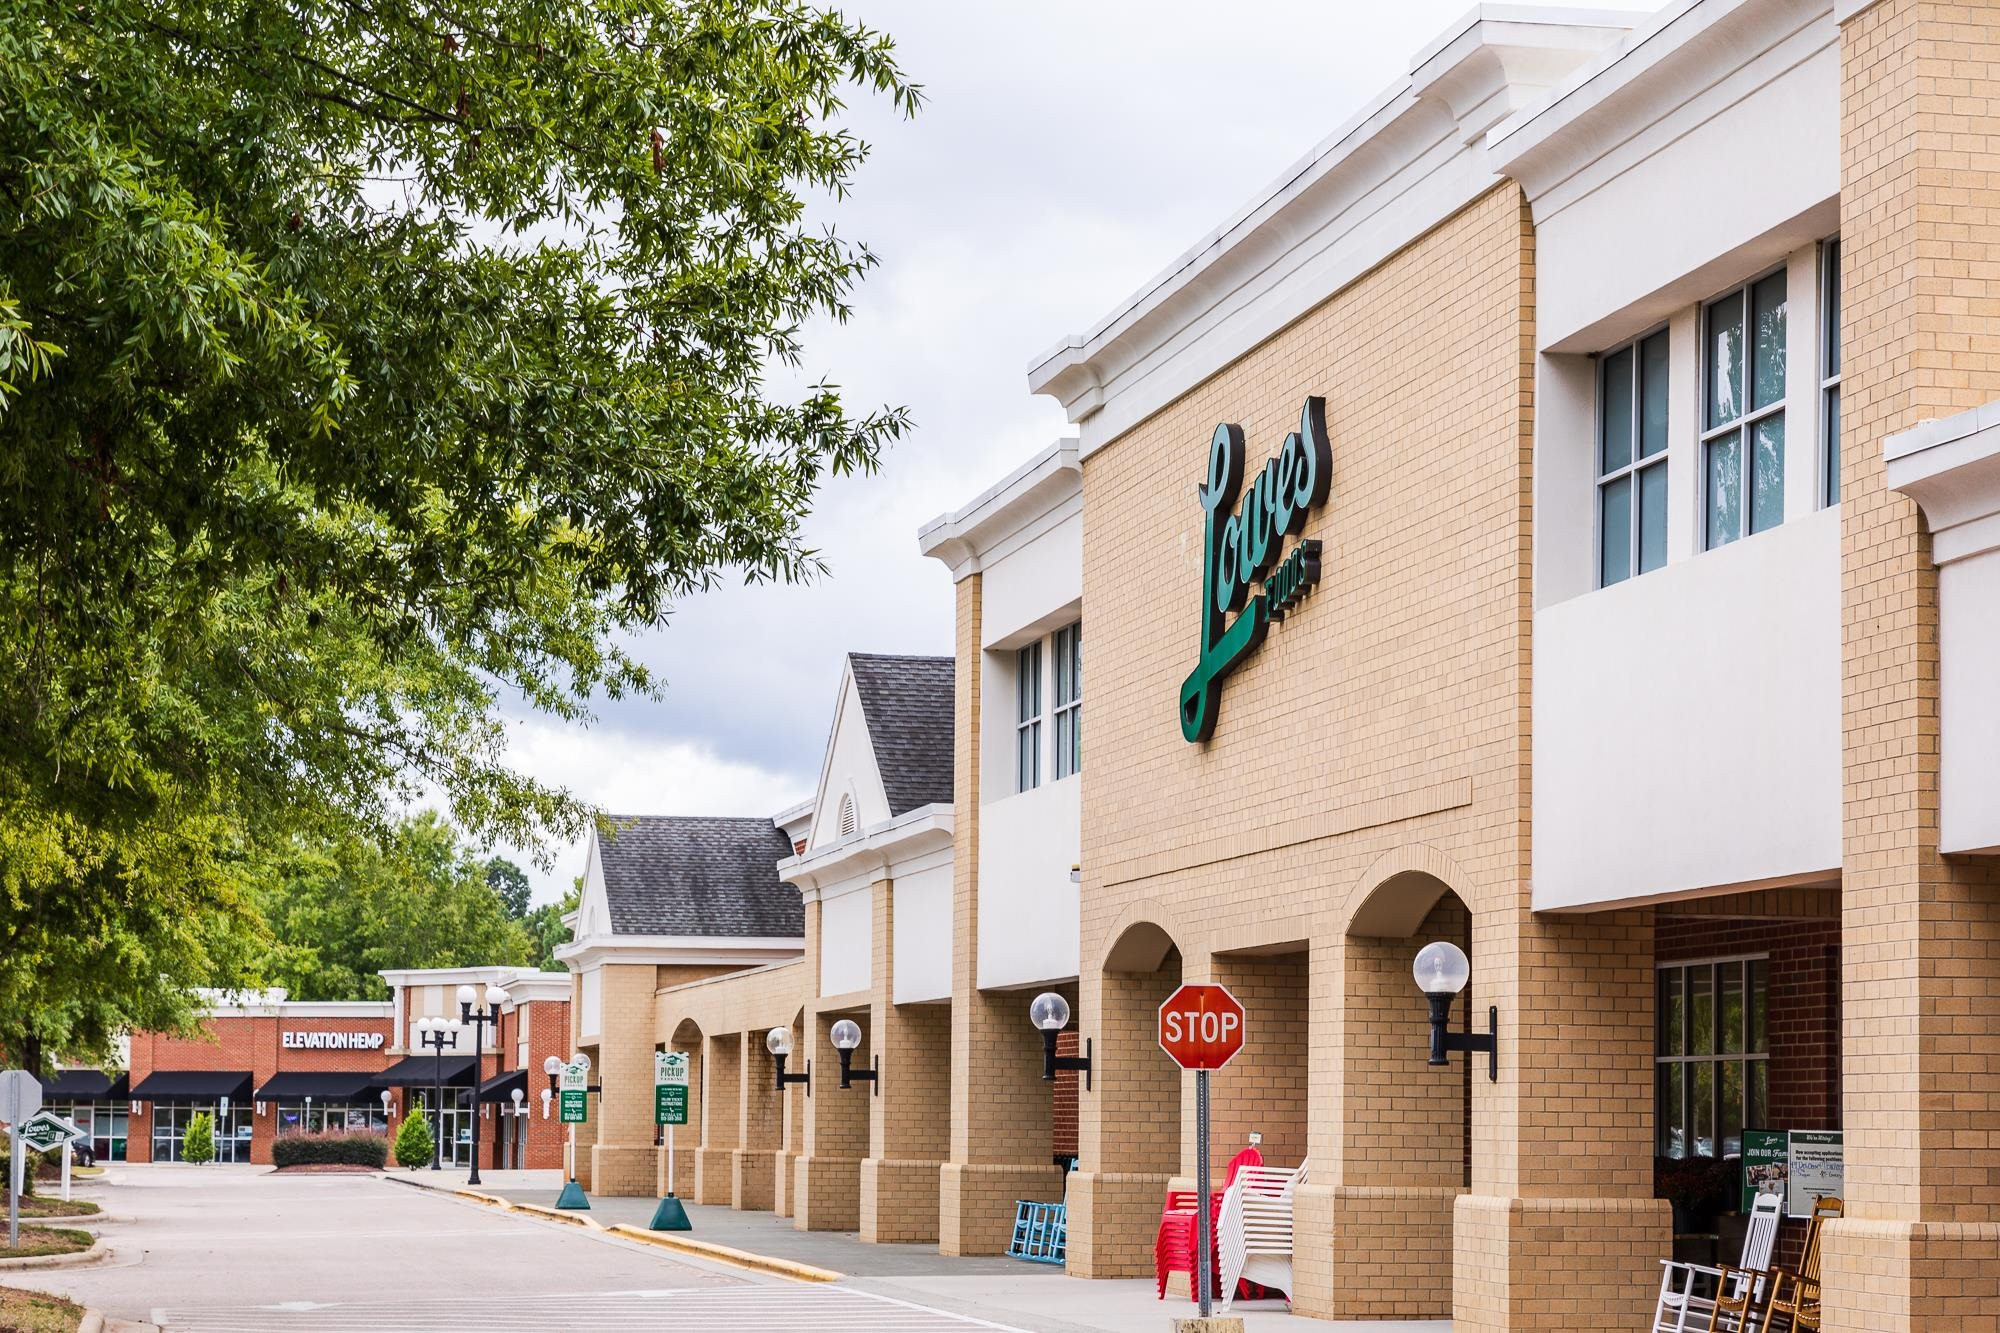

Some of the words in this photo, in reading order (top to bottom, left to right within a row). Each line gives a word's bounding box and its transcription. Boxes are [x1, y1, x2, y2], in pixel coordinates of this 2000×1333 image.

[1165, 1011, 1239, 1043] STOP
[282, 1031, 347, 1049] ELEVATION
[348, 1033, 384, 1049] HEMP
[661, 1067, 684, 1077] PICKUP
[564, 1075, 584, 1084] PICKUP
[1747, 1149, 1760, 1157] JOIN
[1760, 1149, 1772, 1157] OUR
[1772, 1149, 1789, 1158] Fam
